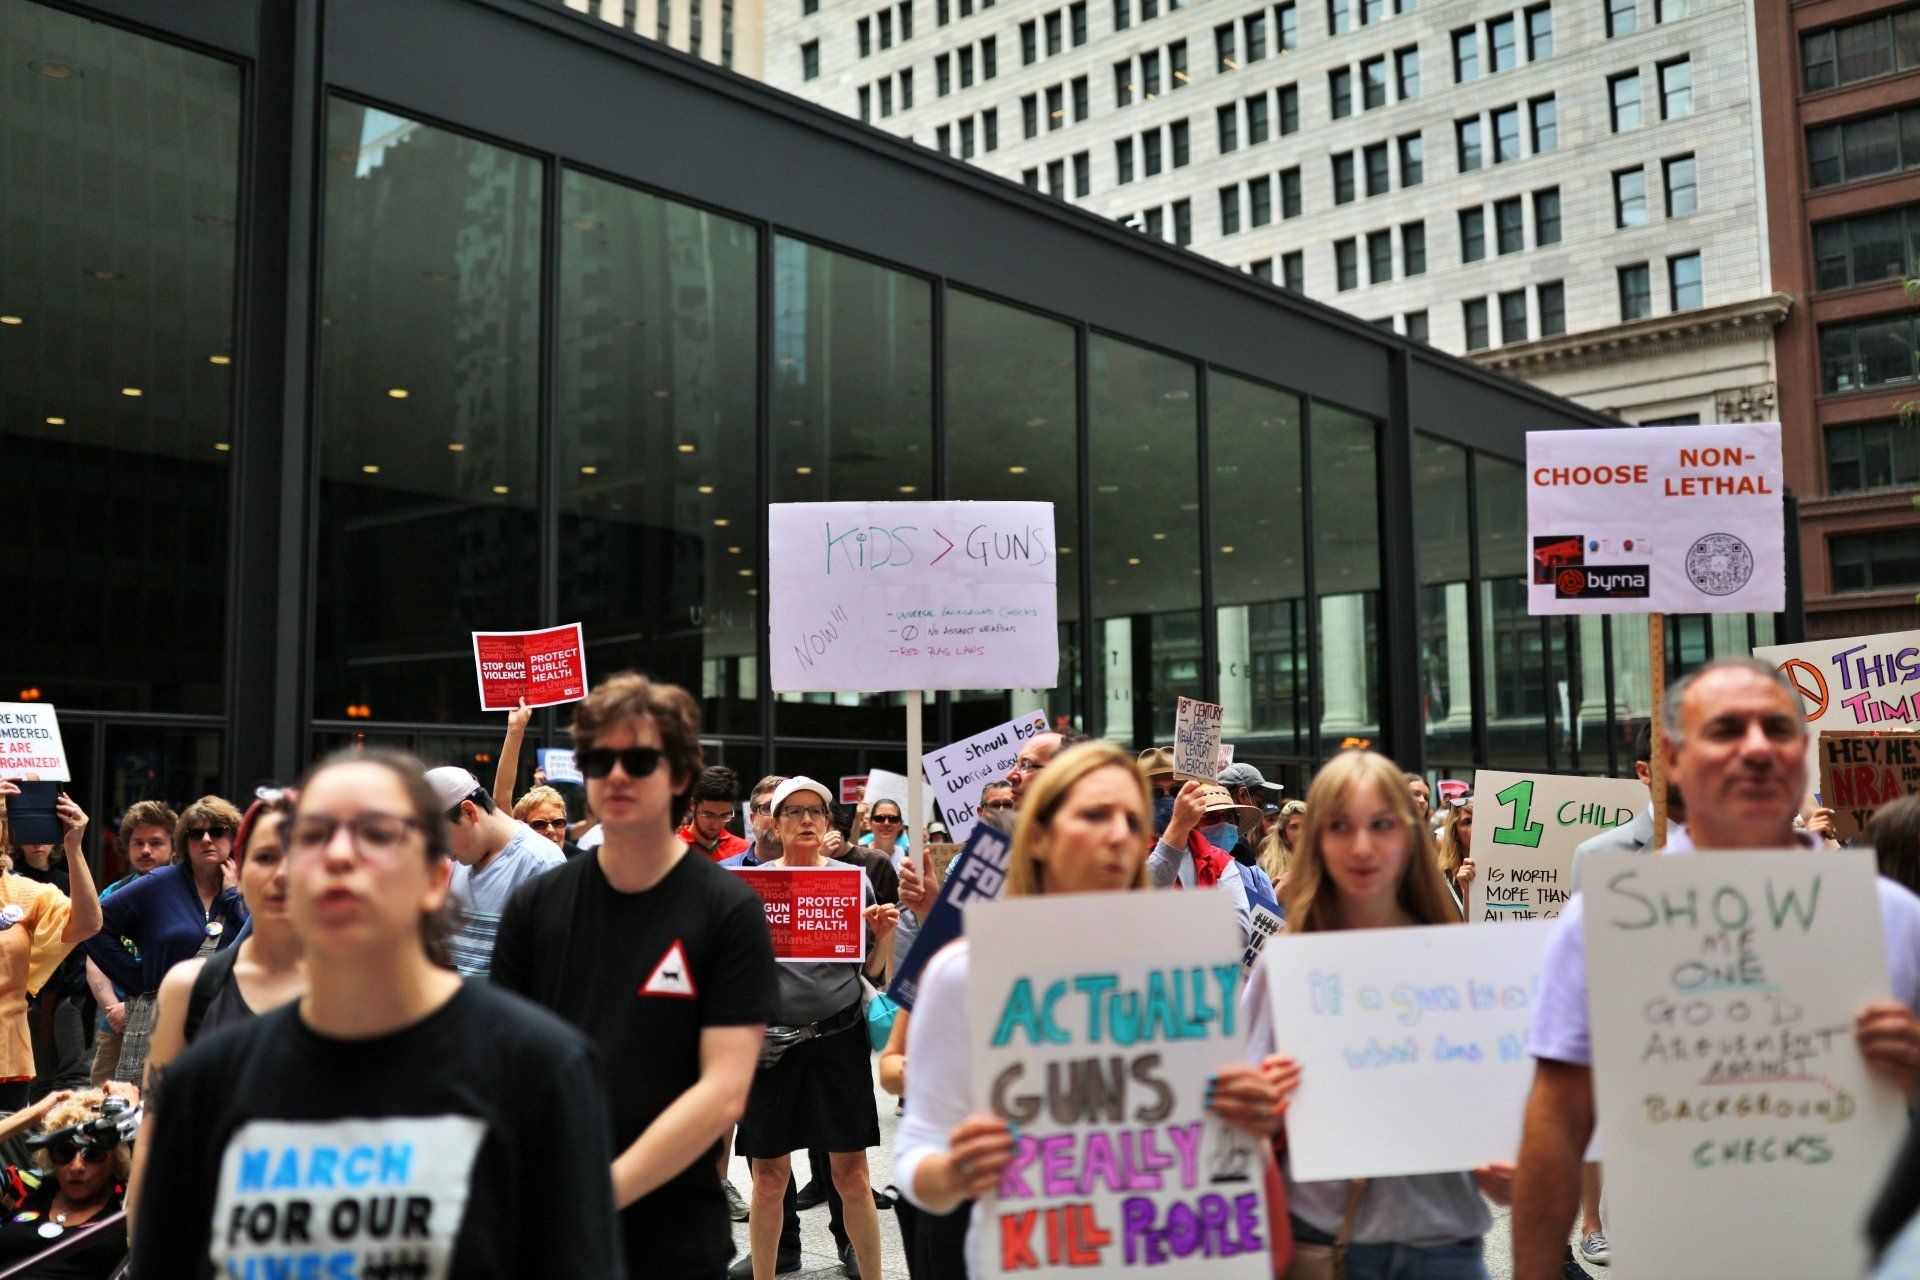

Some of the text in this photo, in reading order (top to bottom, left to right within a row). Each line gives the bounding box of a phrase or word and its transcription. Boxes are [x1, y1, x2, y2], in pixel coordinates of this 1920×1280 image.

[1679, 447, 1756, 468] NON-
[1533, 465, 1648, 486] CHOOSE
[1664, 476, 1772, 497] LETHAL
[966, 524, 1046, 566] GUNS
[1587, 571, 1646, 591] byrna
[481, 651, 525, 660] Sandy Hook
[530, 648, 578, 664] PROTECT
[956, 646, 985, 656] LAWS
[482, 662, 525, 671] STOP GUN
[483, 671, 526, 679] VIOLENCE
[531, 660, 569, 673] PUBLIC
[532, 668, 572, 683] HEALTH
[1832, 644, 1920, 691] THIS
[15, 714, 38, 724] NOT
[1194, 703, 1223, 720] CENTURY
[0, 728, 52, 740] MBERED,
[9, 742, 33, 753] ARE
[935, 756, 951, 776] I
[1013, 722, 1036, 741] be
[1186, 741, 1211, 759] CENTURY
[1827, 738, 1882, 765] HEY,
[1177, 756, 1215, 778] WEAPONS
[1831, 766, 1904, 808] NRA
[1492, 780, 1633, 848] 1 CHILD
[1488, 867, 1558, 883] IS WORTH
[797, 896, 857, 907] PROTECT
[1486, 886, 1572, 904] MORE THAN
[1608, 870, 1822, 931] SHOW
[763, 902, 790, 913] GUN
[797, 908, 844, 918] PUBLIC
[1512, 911, 1538, 921] THE
[797, 920, 848, 931] HEALTH
[814, 931, 857, 941] Uvalde
[990, 964, 1241, 1048] ACTUALLY
[1358, 984, 1383, 1010] a
[1644, 995, 1804, 1026] GOOD
[991, 1053, 1174, 1126] GUNS
[1643, 1092, 1855, 1125] BACKGROUND
[998, 1122, 1202, 1199] REALLY
[1692, 1134, 1834, 1169] CHECKS
[237, 1142, 414, 1194] MARCH
[228, 1195, 432, 1247] FOR OUR
[1000, 1192, 1263, 1272] KILL PEOPLE
